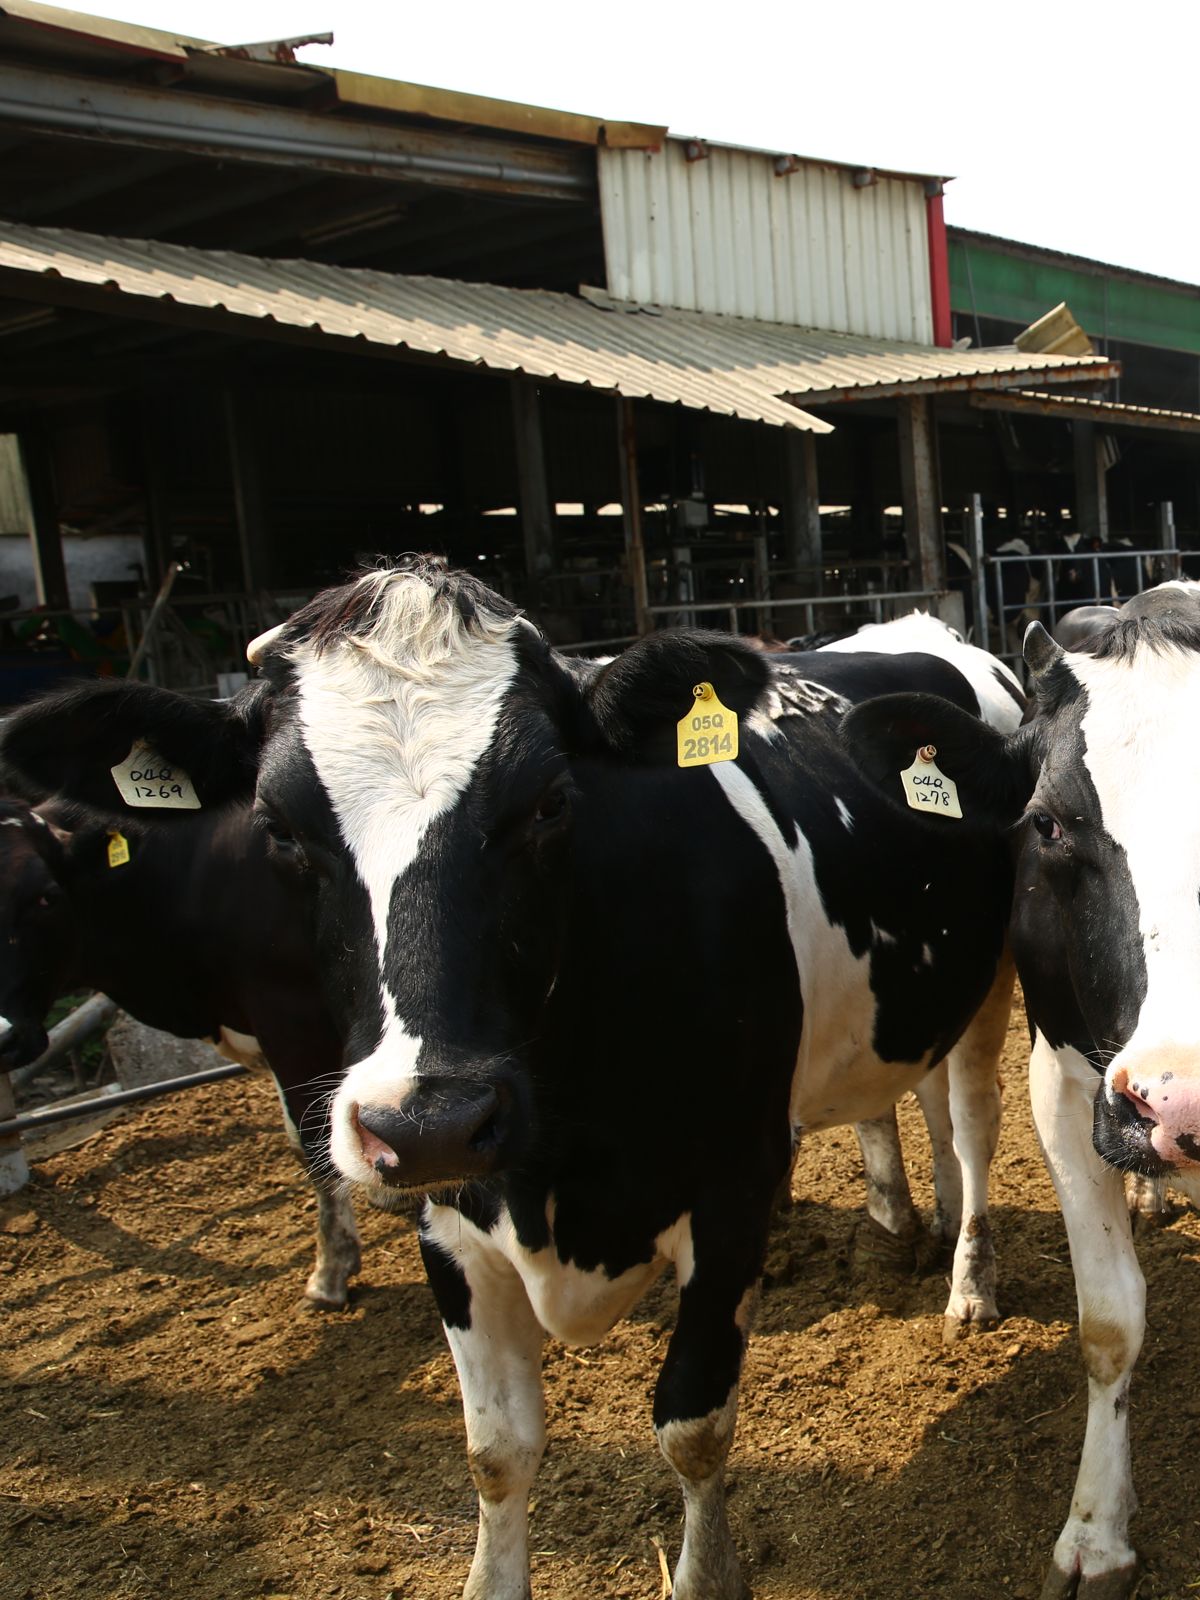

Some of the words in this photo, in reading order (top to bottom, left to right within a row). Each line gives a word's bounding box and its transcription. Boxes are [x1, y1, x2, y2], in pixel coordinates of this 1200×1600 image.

[692, 713, 724, 731] 05Q
[684, 732, 733, 760] 2814
[913, 776, 943, 789] 04Q
[135, 785, 183, 798] 1269
[915, 790, 950, 806] 1278
